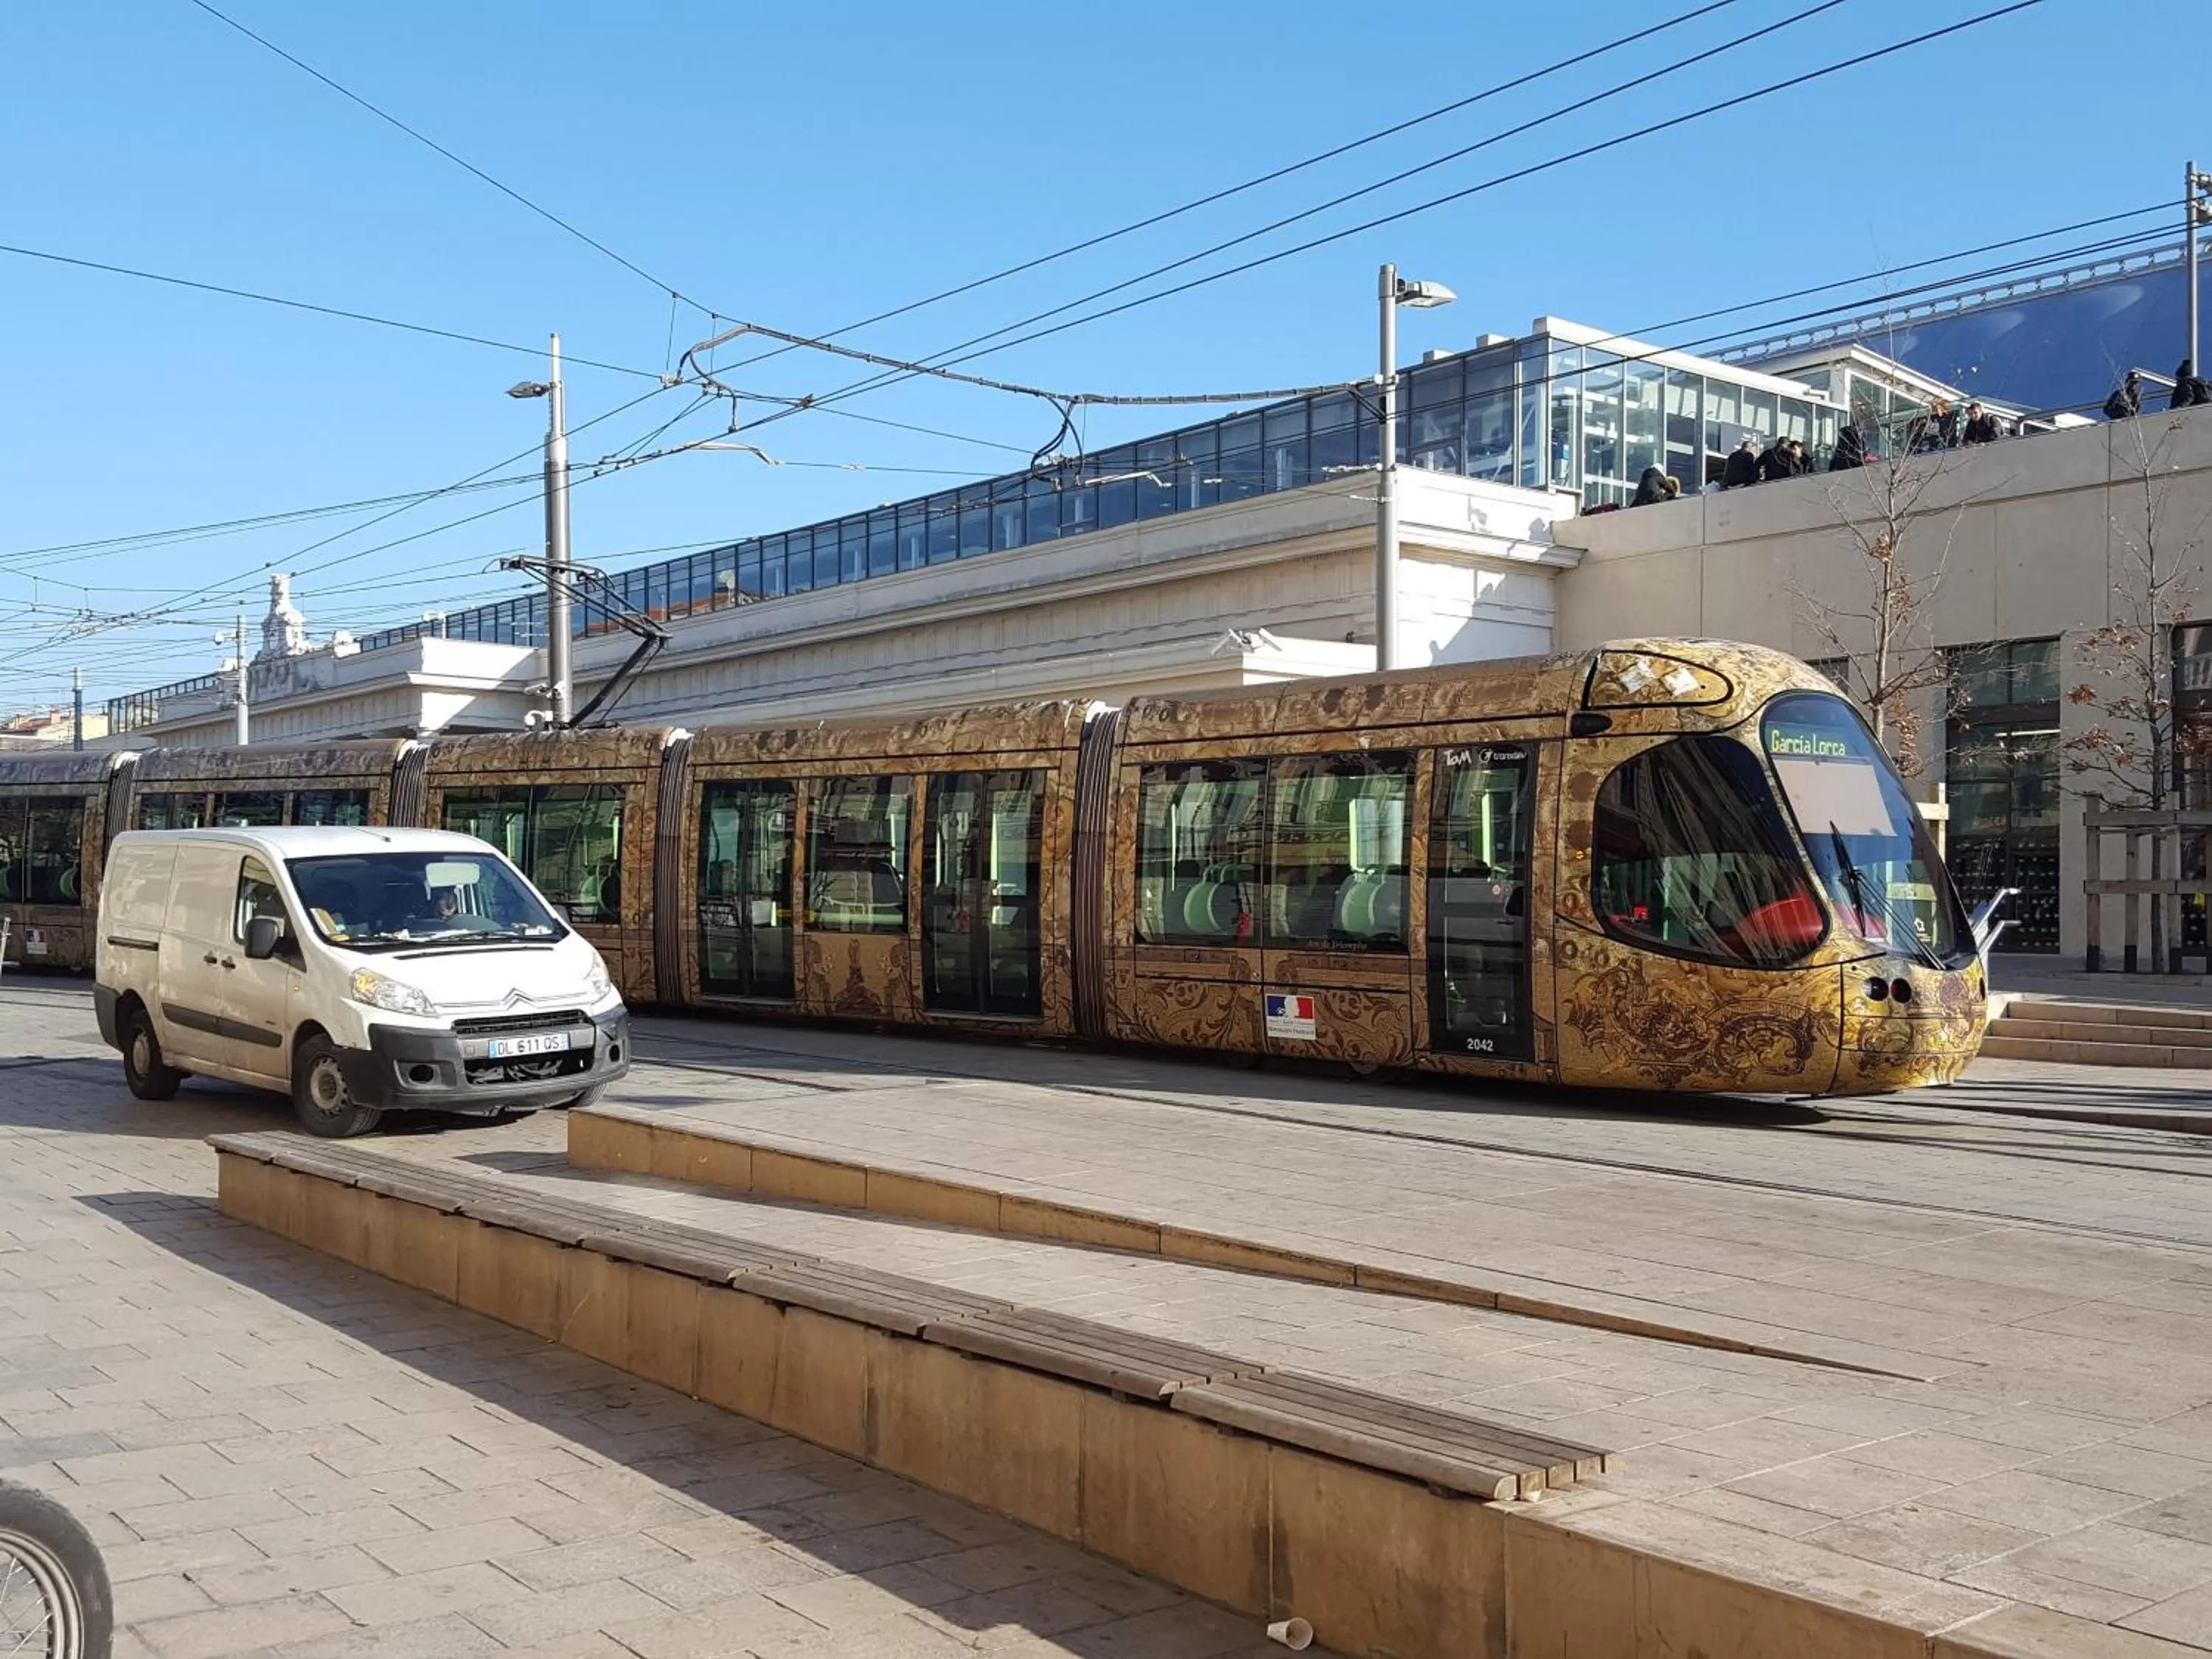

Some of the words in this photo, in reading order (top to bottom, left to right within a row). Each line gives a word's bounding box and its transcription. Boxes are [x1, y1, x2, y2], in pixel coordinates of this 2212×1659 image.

[1771, 729, 1811, 755] Garcia
[1812, 733, 1846, 756] Lorca
[1444, 749, 1472, 767] TaM
[498, 1042, 513, 1055] DL
[517, 1038, 540, 1053] 611
[1467, 1037, 1494, 1052] 2042
